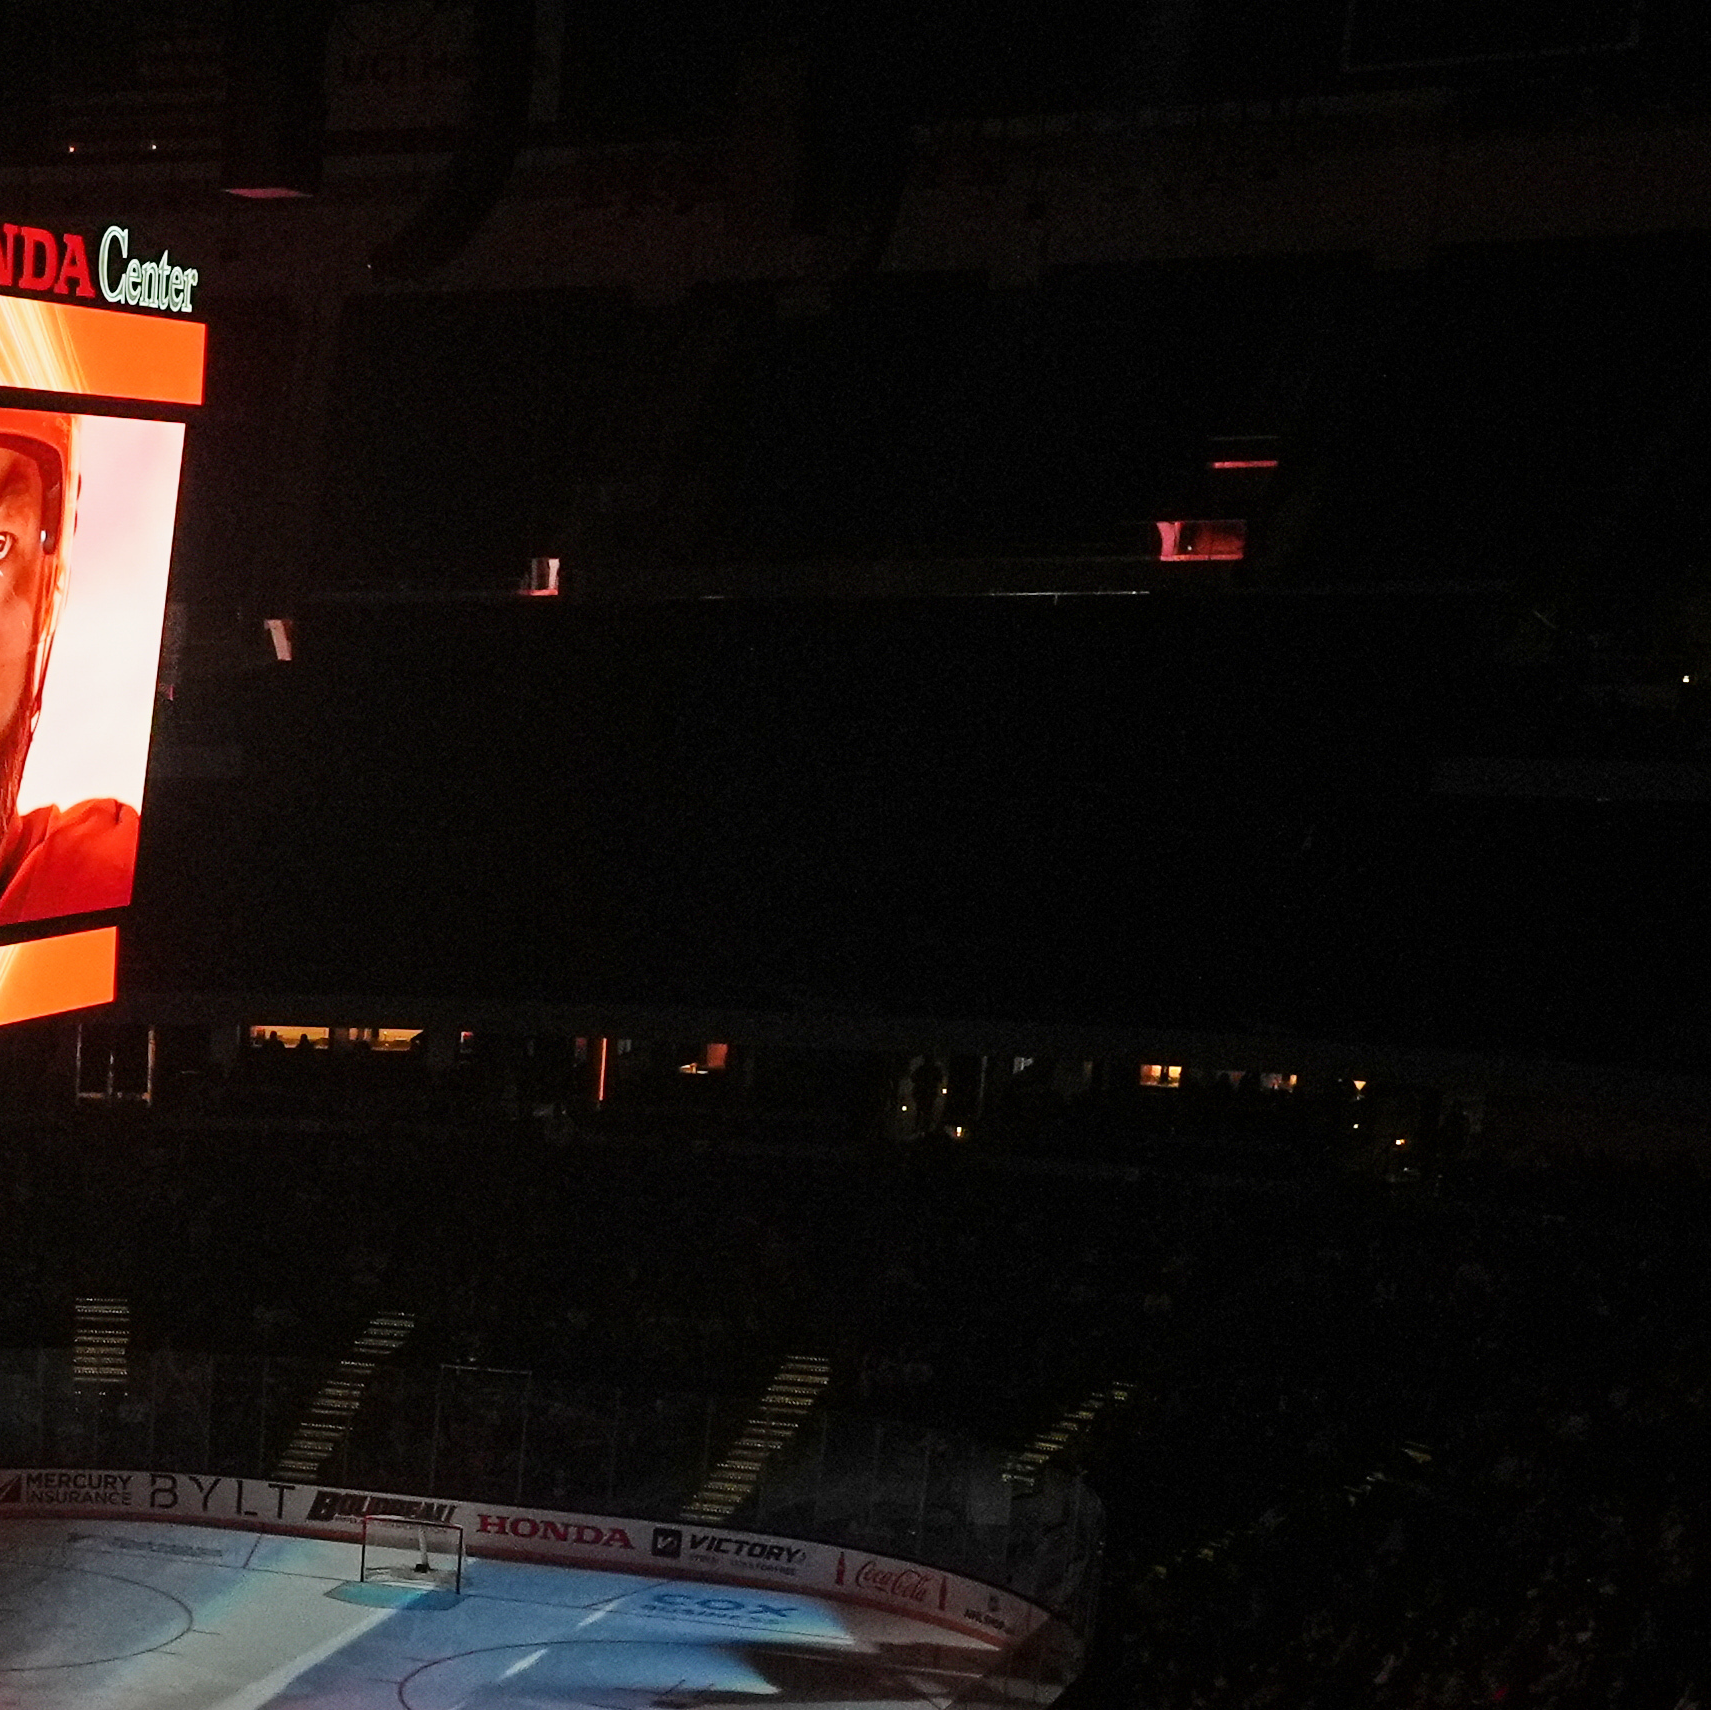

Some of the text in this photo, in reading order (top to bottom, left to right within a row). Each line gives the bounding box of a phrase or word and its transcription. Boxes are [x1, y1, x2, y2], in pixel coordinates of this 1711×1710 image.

[98, 224, 199, 314] Center
[26, 1472, 131, 1490] MERCURY
[149, 1472, 295, 1520] BYLT
[26, 1490, 131, 1507] INSURANCE
[476, 1513, 636, 1550] HONDA
[689, 1533, 802, 1565] VICTORY
[653, 1593, 799, 1618] COX
